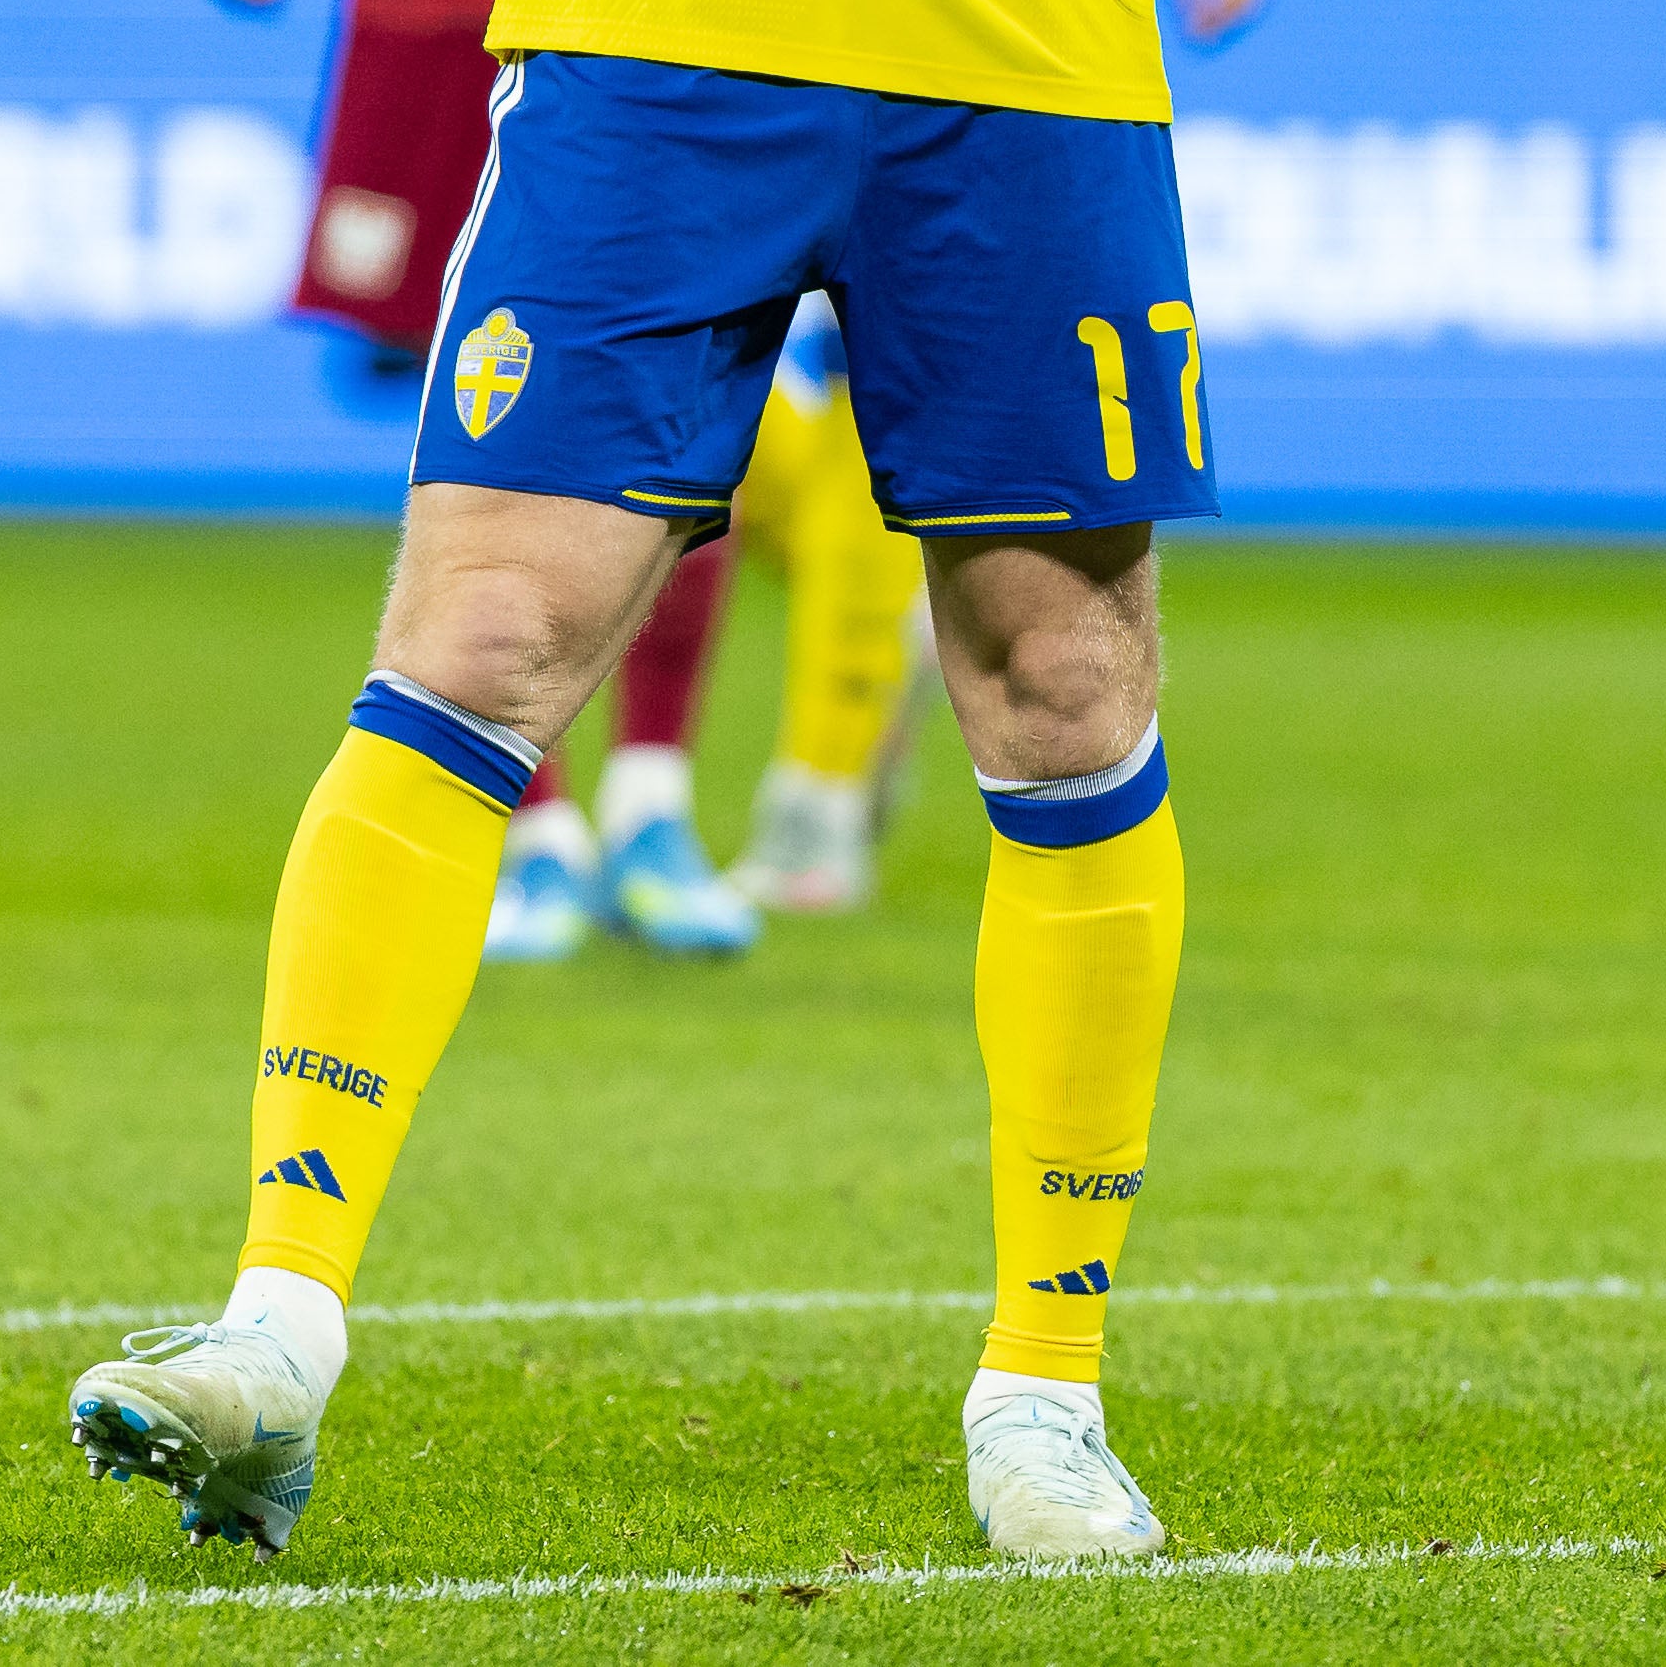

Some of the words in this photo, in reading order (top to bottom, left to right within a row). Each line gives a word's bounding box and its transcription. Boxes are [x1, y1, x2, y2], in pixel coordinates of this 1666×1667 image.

[467, 344, 520, 357] SVERIGE
[1077, 300, 1205, 482] 17
[263, 1045, 389, 1109] SVERIGE
[1039, 1165, 1145, 1201] SVERIG
